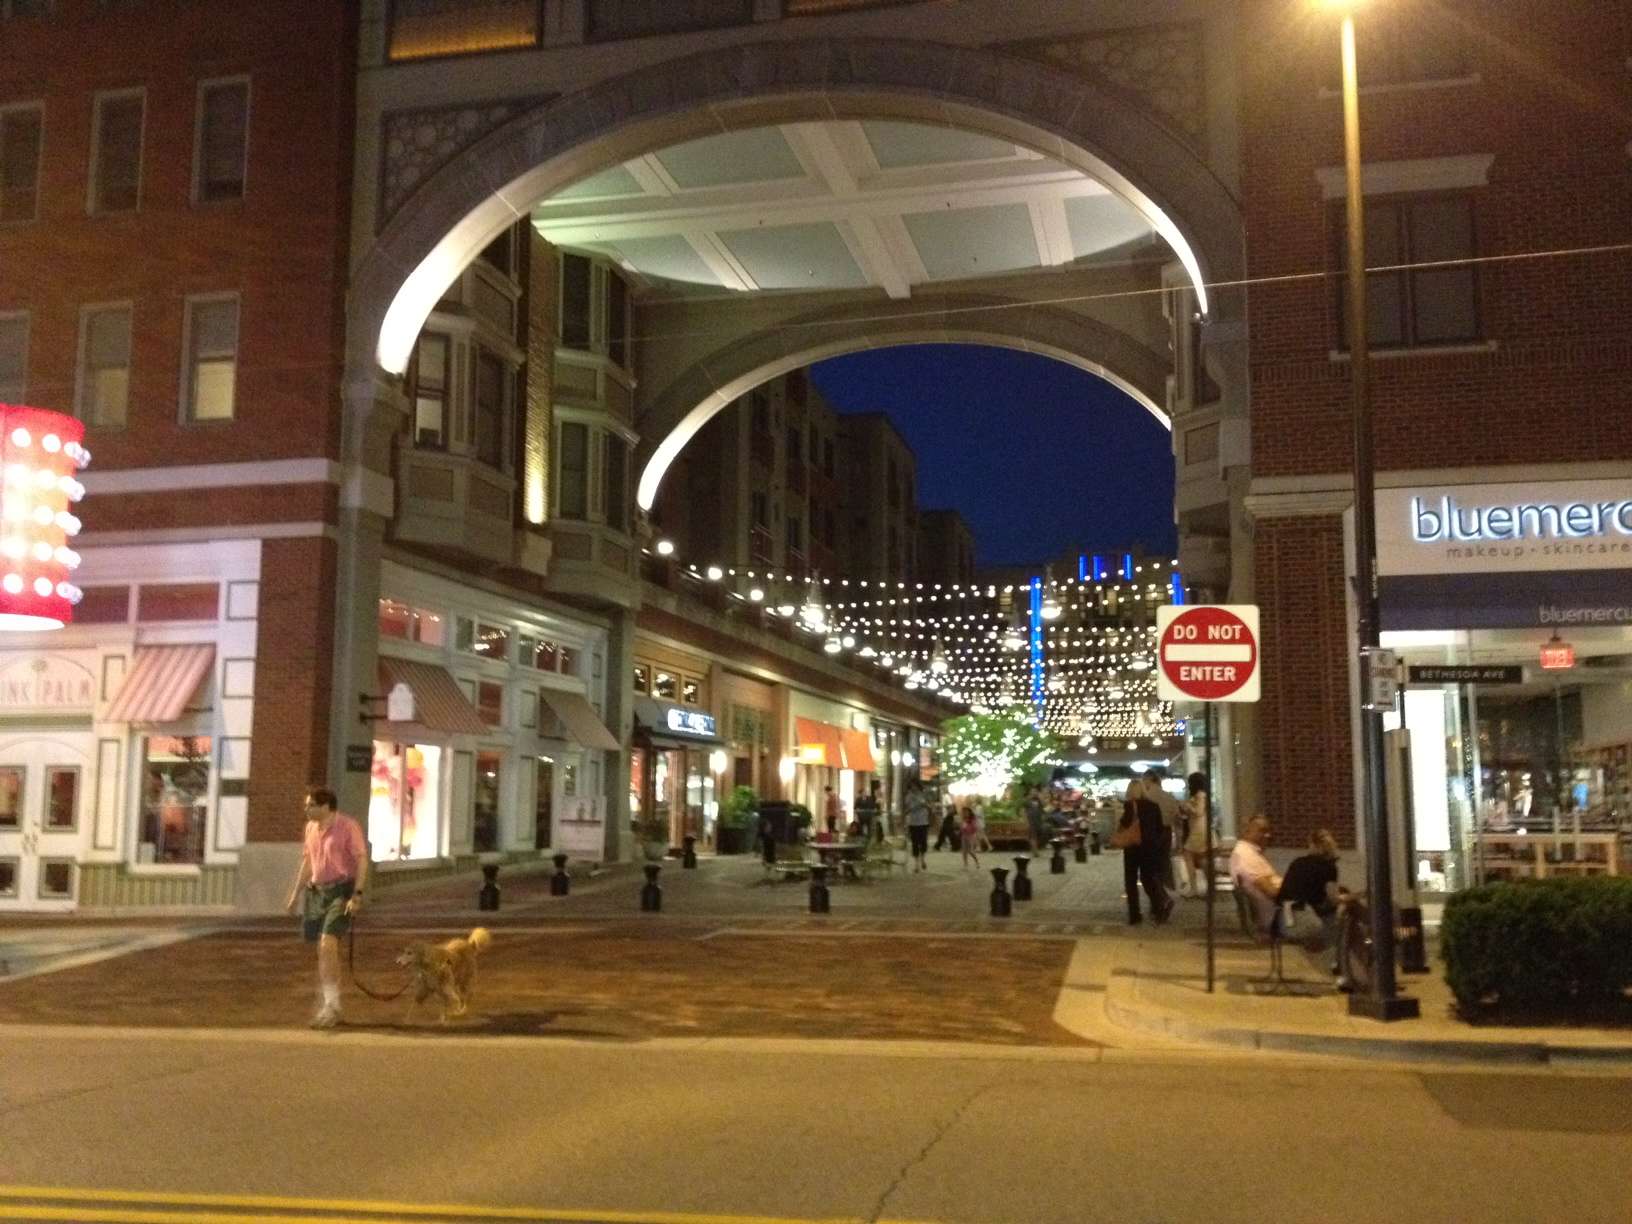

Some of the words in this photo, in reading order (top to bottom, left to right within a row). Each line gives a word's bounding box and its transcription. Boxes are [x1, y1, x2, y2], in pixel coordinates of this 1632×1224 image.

[1446, 546, 1524, 559] makeup
[1543, 542, 1631, 555] skincare
[1173, 624, 1198, 639] DO
[1207, 624, 1243, 639] NOT
[1180, 665, 1236, 681] ENTER
[1419, 670, 1479, 680] BETHESDA
[1483, 670, 1505, 680] AVE
